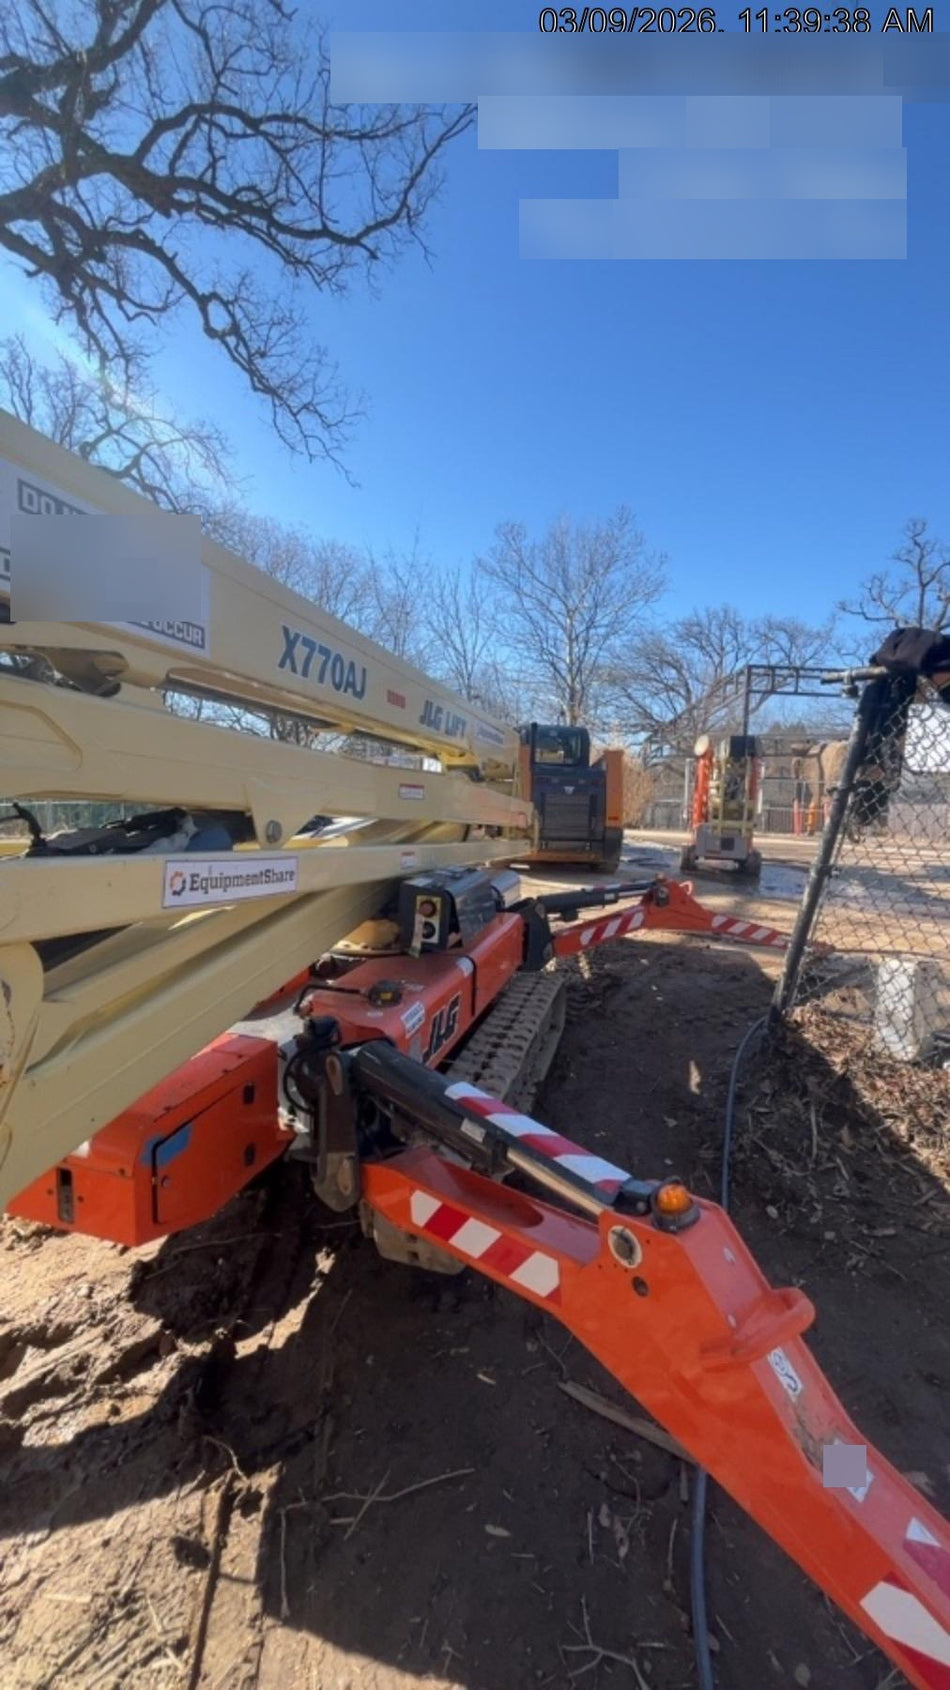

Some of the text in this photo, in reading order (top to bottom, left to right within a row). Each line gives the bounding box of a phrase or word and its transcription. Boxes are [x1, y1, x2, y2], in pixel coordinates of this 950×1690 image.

[277, 625, 367, 700] X770AJ
[418, 700, 443, 731] JLG
[444, 711, 467, 737] LIFT
[189, 868, 295, 894] EquipmentShare
[422, 990, 461, 1064] JLG
